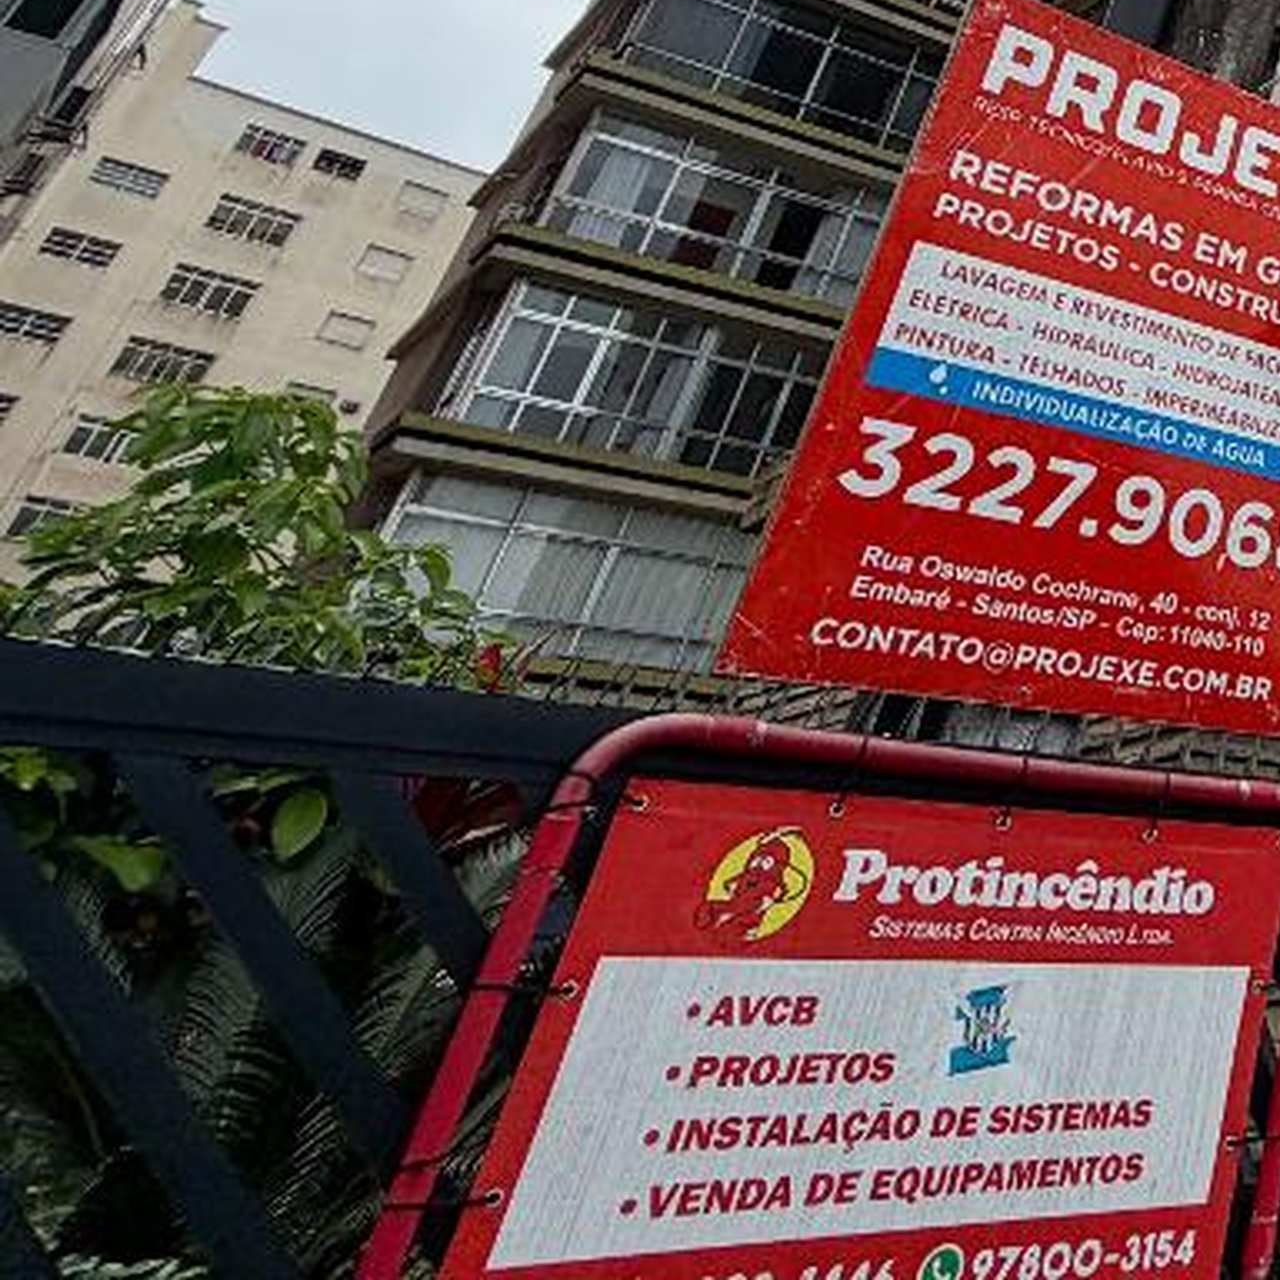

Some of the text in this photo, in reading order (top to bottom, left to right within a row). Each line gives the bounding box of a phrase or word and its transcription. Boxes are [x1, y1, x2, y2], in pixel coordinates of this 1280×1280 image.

[930, 191, 1122, 274] PROJETOS
[946, 149, 1187, 254] REFORMAS
[1191, 231, 1249, 275] EM
[938, 258, 1048, 306] LAVAGEM
[1051, 291, 1068, 311] E
[1216, 340, 1242, 362] DE
[892, 321, 999, 366] PINTURA
[1017, 352, 1128, 398] TELHADOS
[1180, 432, 1209, 454] DE
[848, 572, 954, 610] Embaré
[969, 591, 1098, 632] Santos/SP
[858, 545, 917, 574] Rua
[916, 553, 1029, 592] Oswaldo
[1147, 588, 1180, 616] 40
[1247, 609, 1272, 631] 12
[809, 617, 1271, 702] CONTATO@PROJEXE.COM.BR
[833, 849, 1215, 914] Protincêndio
[706, 996, 819, 1026] AVCB
[686, 1053, 896, 1088] PROJETOS
[666, 1099, 1152, 1153] INSTALAÇÃO DE SISTEMAS
[648, 1153, 1144, 1217] VENDA DE EQUIPAMENTOS
[972, 1229, 1196, 1280] 97800-3154
